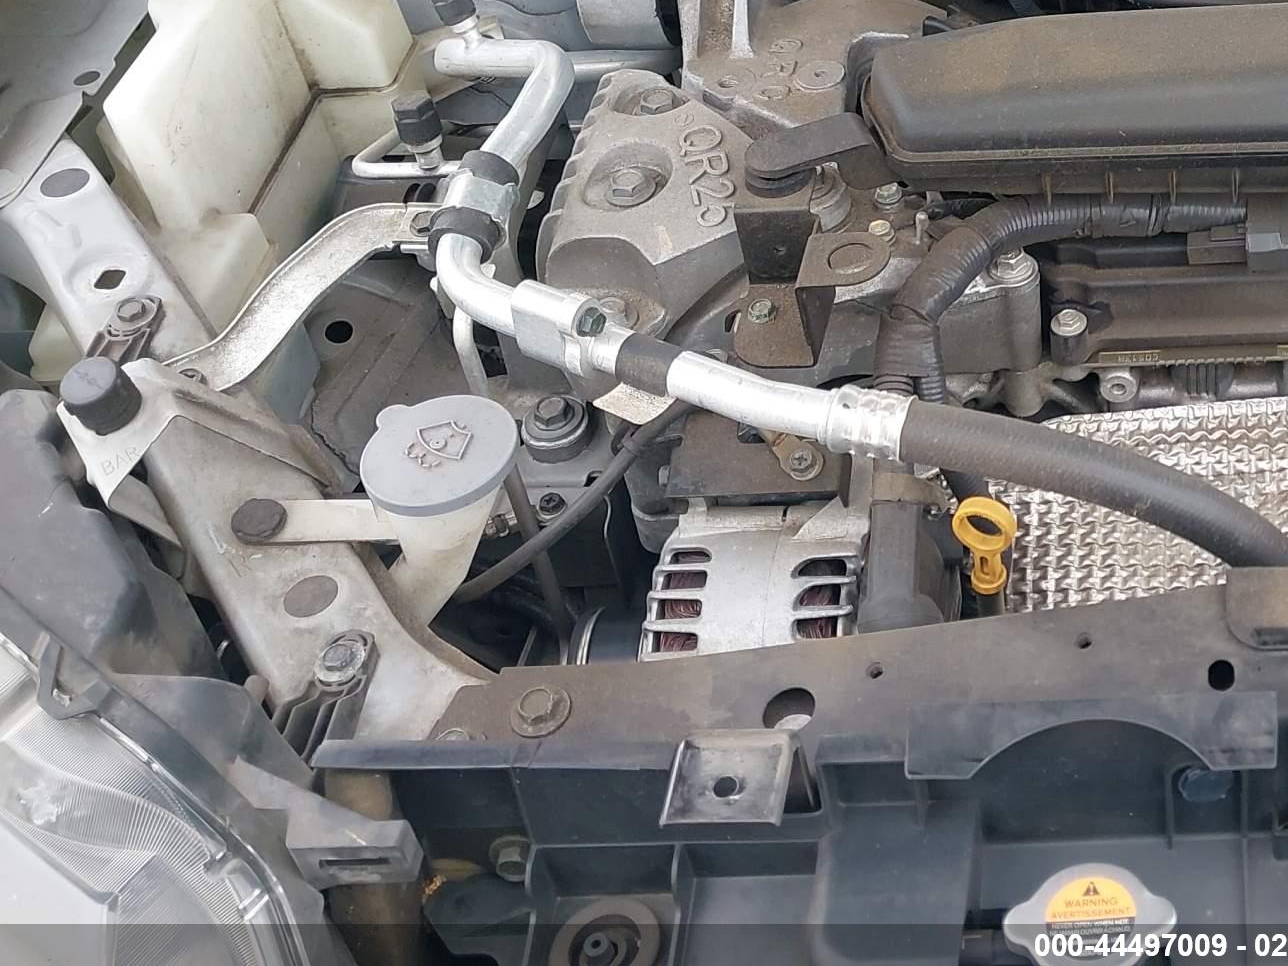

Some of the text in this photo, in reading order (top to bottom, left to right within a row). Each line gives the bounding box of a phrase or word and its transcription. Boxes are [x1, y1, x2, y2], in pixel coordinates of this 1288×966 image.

[679, 124, 736, 228] QR25
[101, 446, 141, 476] BAR
[1052, 906, 1131, 920] AVERTISSEMENT
[1064, 897, 1118, 908] WARNING
